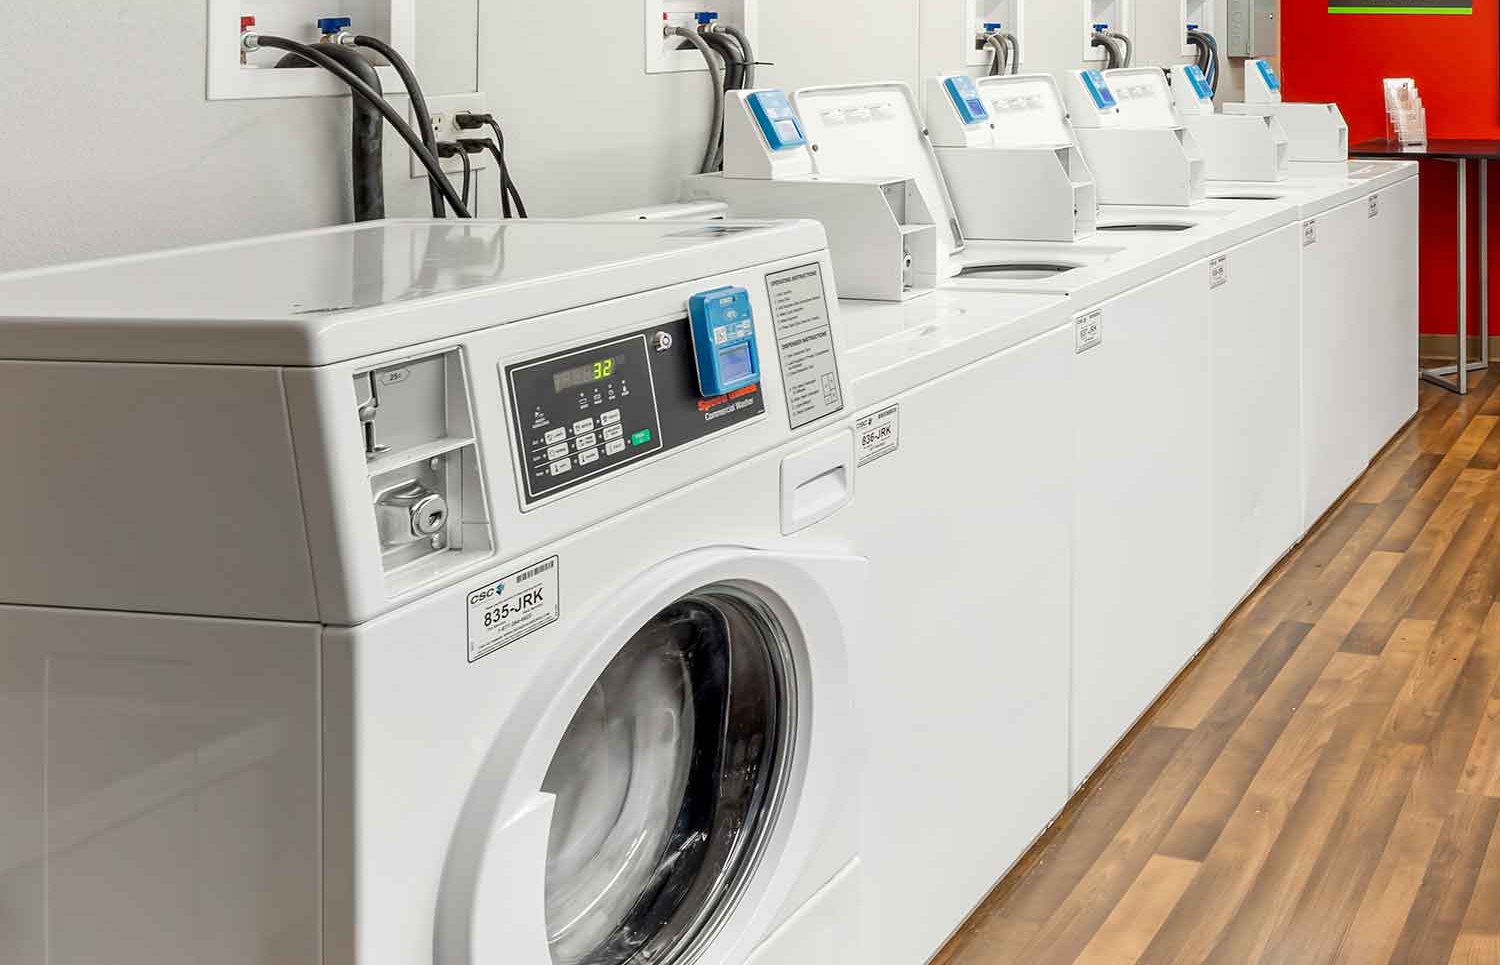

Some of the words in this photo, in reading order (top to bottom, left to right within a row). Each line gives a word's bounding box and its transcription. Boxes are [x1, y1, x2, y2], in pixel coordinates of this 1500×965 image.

[593, 358, 612, 379] 32
[470, 588, 494, 605] CSC
[483, 587, 544, 627] 835-JRK
